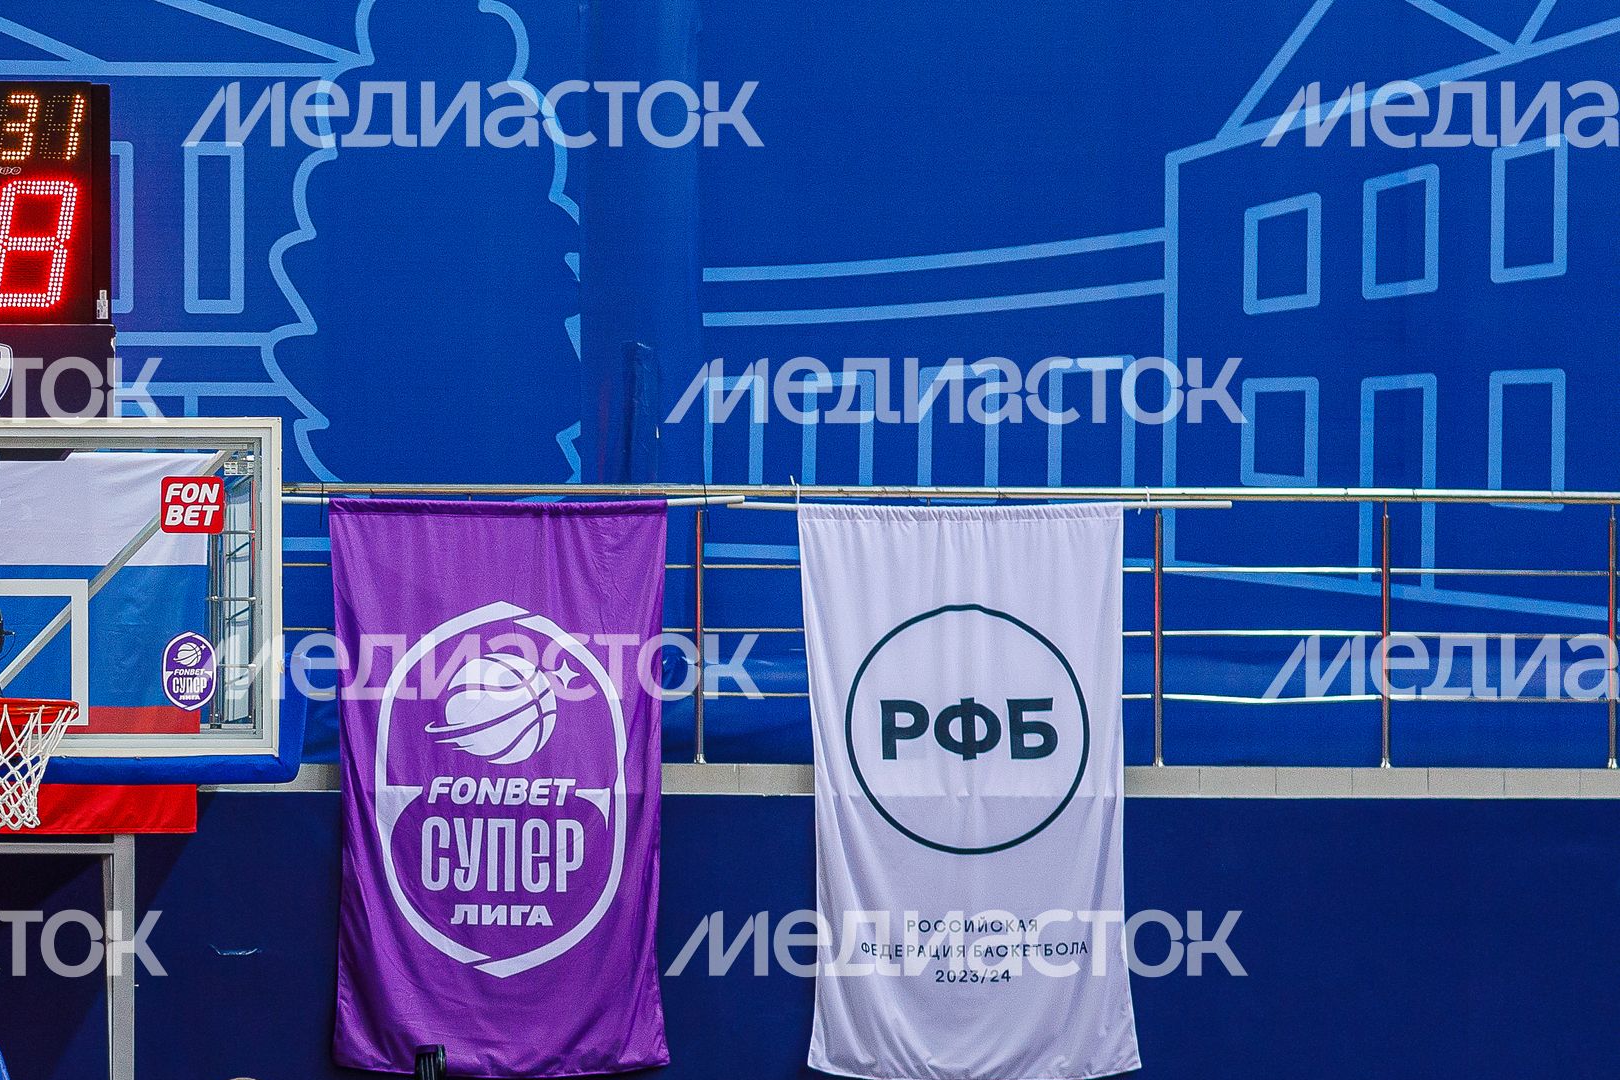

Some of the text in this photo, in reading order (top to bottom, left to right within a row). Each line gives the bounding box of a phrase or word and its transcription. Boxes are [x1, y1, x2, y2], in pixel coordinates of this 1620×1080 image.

[165, 483, 220, 503] FON
[165, 504, 220, 526] BET
[173, 668, 205, 676] FONBET
[880, 697, 1058, 761] РФБ
[427, 776, 576, 806] FONBET
[450, 904, 553, 926] ЛИГА
[906, 917, 1038, 933] РОССИЙСКАЯ
[861, 941, 1089, 960] ФЕДЕРАЦИЯ БАСКЕТБОЛА
[935, 969, 1012, 983] 2023/24
